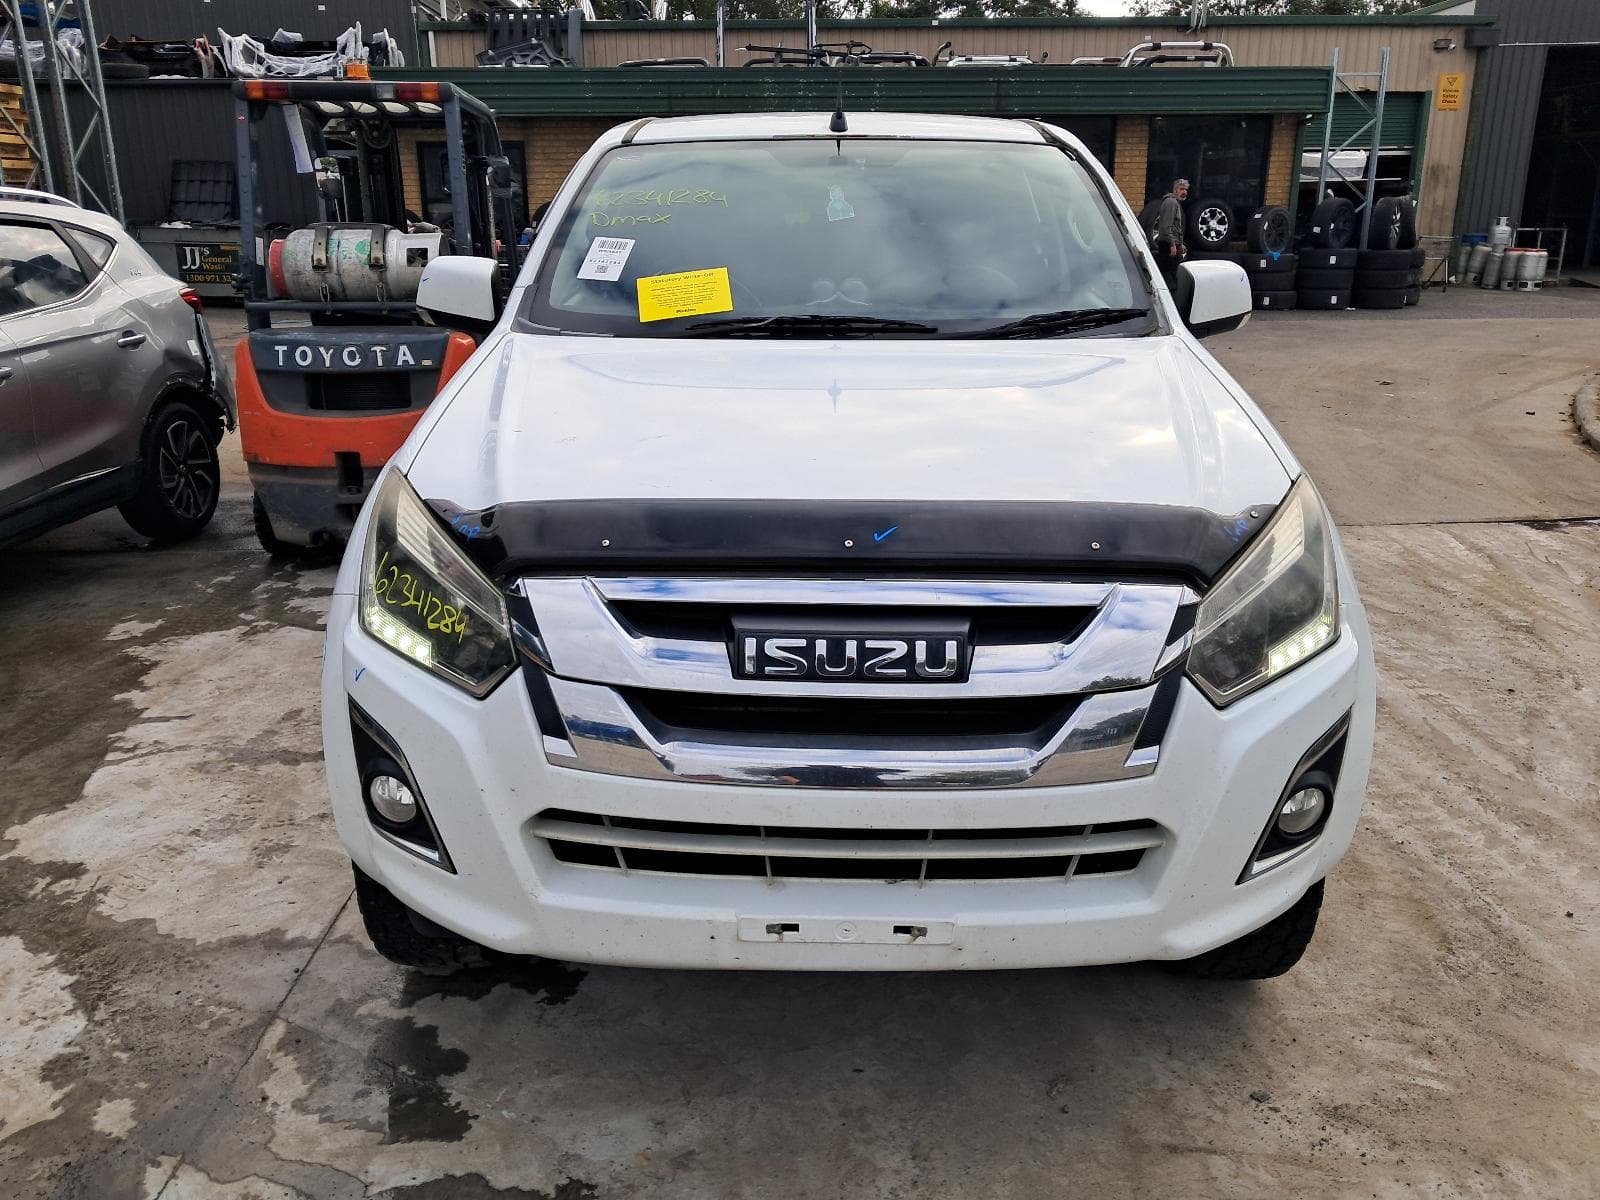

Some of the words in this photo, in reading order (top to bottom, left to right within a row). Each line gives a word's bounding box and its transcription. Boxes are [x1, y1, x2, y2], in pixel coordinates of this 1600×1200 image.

[182, 246, 210, 270] JJ's
[201, 262, 226, 270] Waste
[186, 274, 205, 282] 1300
[205, 274, 220, 282] 971
[650, 276, 682, 285] Statutory
[274, 345, 416, 367] TOYOTA
[374, 551, 468, 644] 62341284
[744, 637, 958, 678] ISUZU
